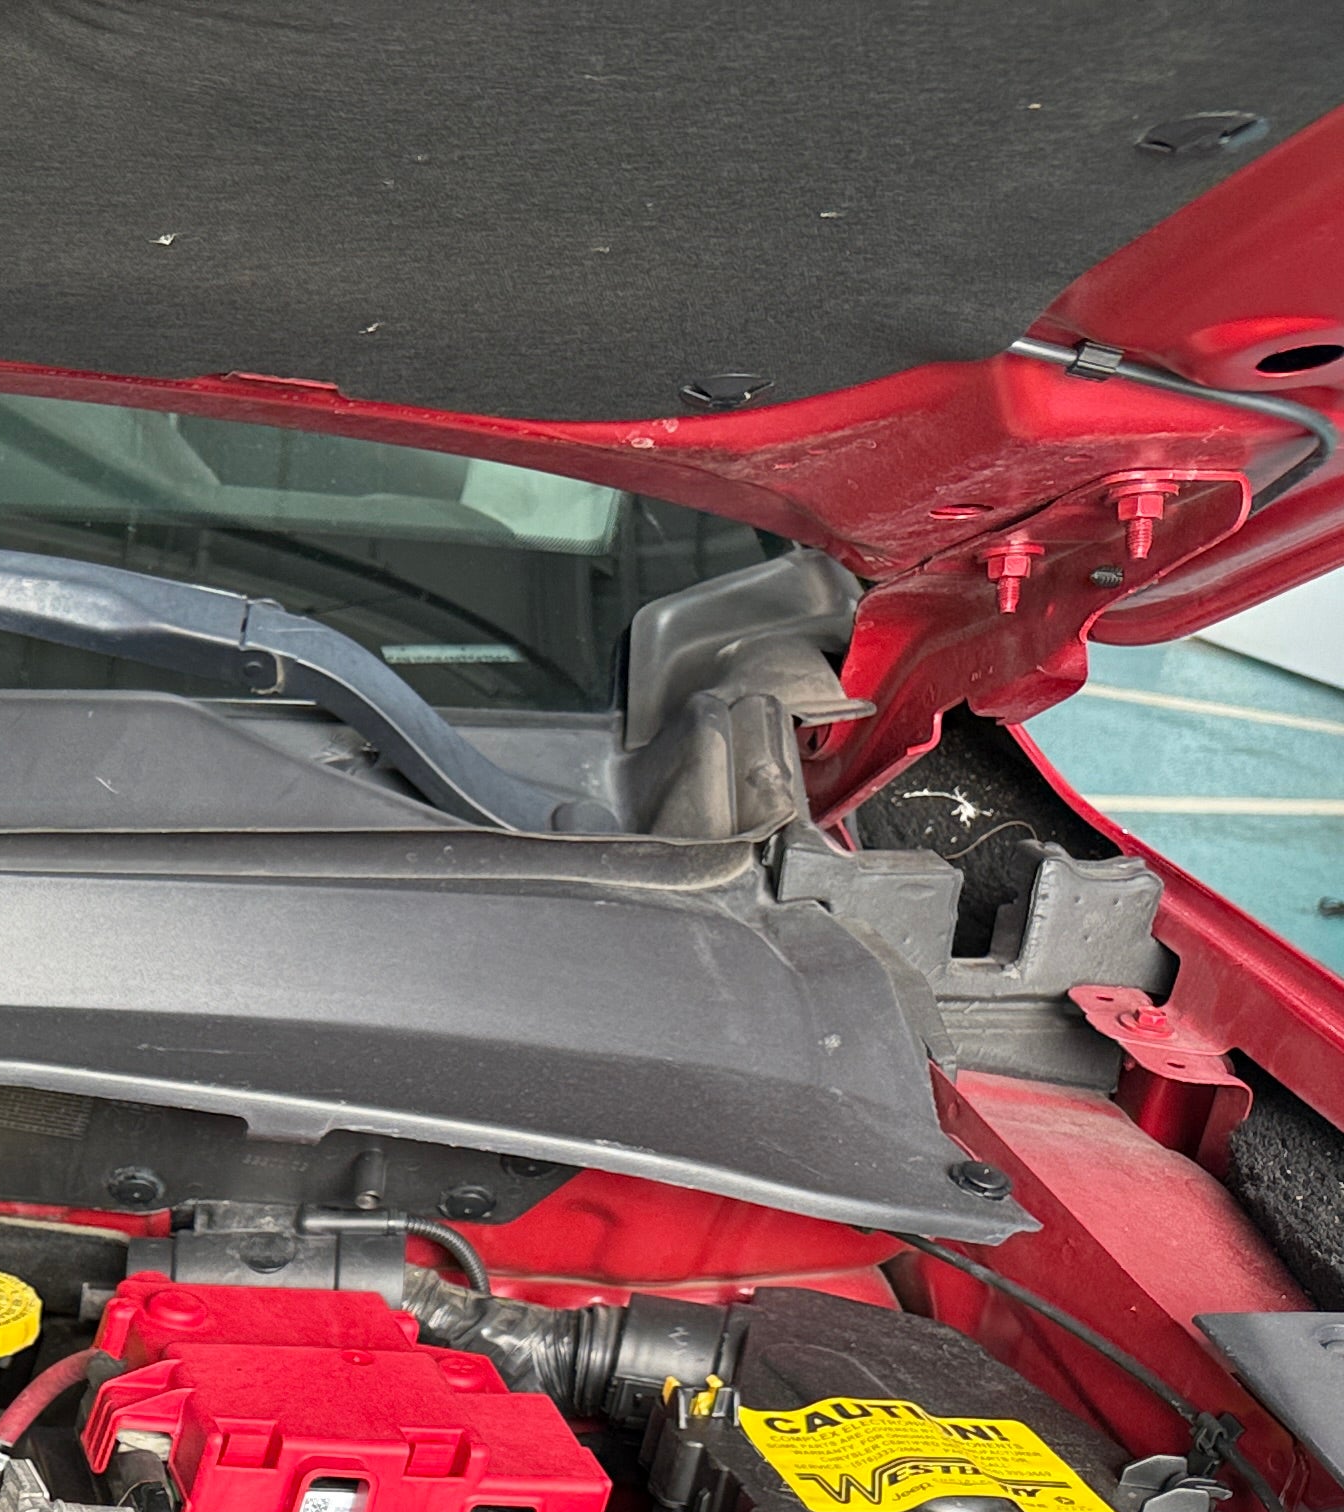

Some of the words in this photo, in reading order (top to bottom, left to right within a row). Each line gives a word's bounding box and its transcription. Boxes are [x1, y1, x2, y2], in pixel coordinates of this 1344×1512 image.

[769, 1430, 839, 1443] COMPLEX
[800, 1440, 837, 1449] PARTS
[840, 1432, 862, 1444] ARE
[861, 1433, 885, 1445] FOR
[820, 1444, 882, 1463] CHRYSLER
